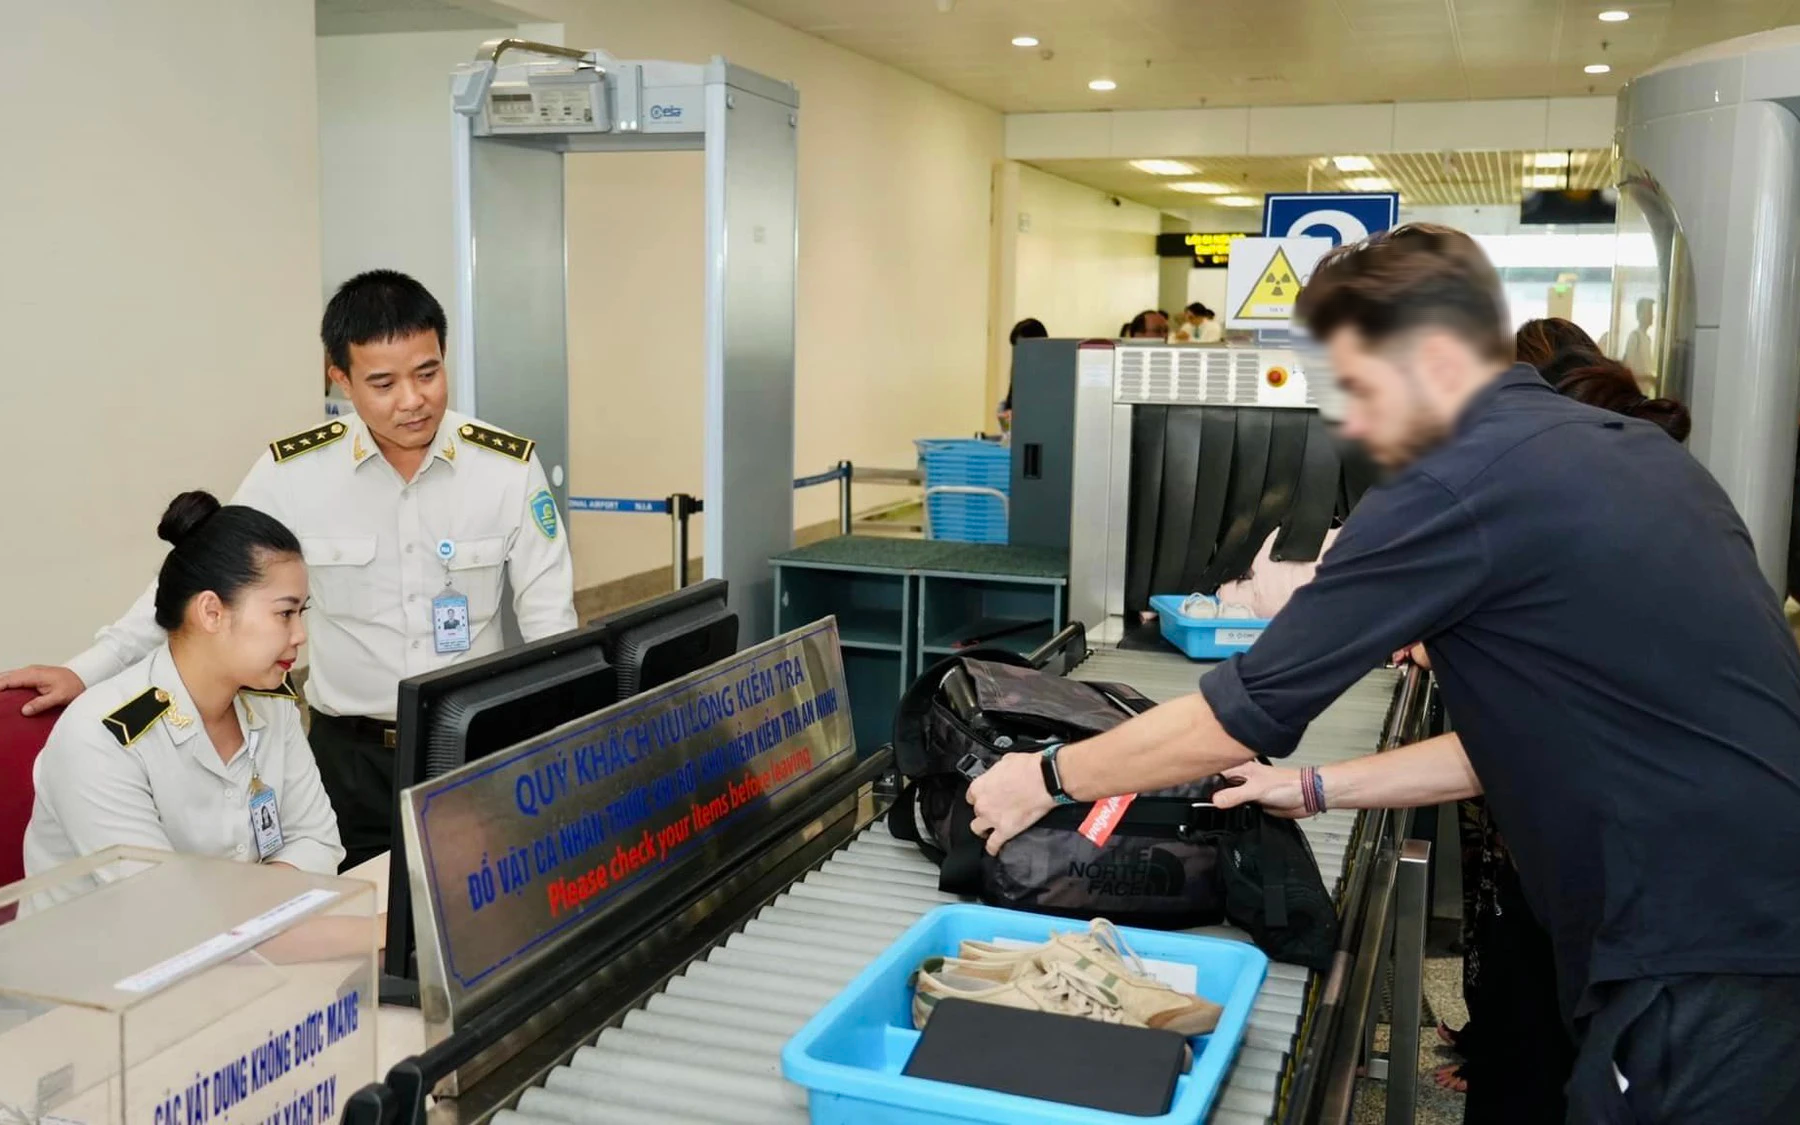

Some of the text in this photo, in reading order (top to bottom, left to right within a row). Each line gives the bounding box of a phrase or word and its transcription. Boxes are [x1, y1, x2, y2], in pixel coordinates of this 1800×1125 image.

[589, 500, 619, 510] AIRPORT
[736, 662, 775, 711] KIỂM
[775, 656, 805, 692] TRA
[782, 707, 802, 737] TRA
[801, 700, 815, 728] AN
[816, 687, 838, 721] NINH
[547, 747, 812, 918] Please check your items before leaving
[1068, 862, 1147, 880] NORTH
[1087, 880, 1147, 896] FACE
[327, 991, 359, 1048] MANG
[316, 1074, 336, 1124] TAY
